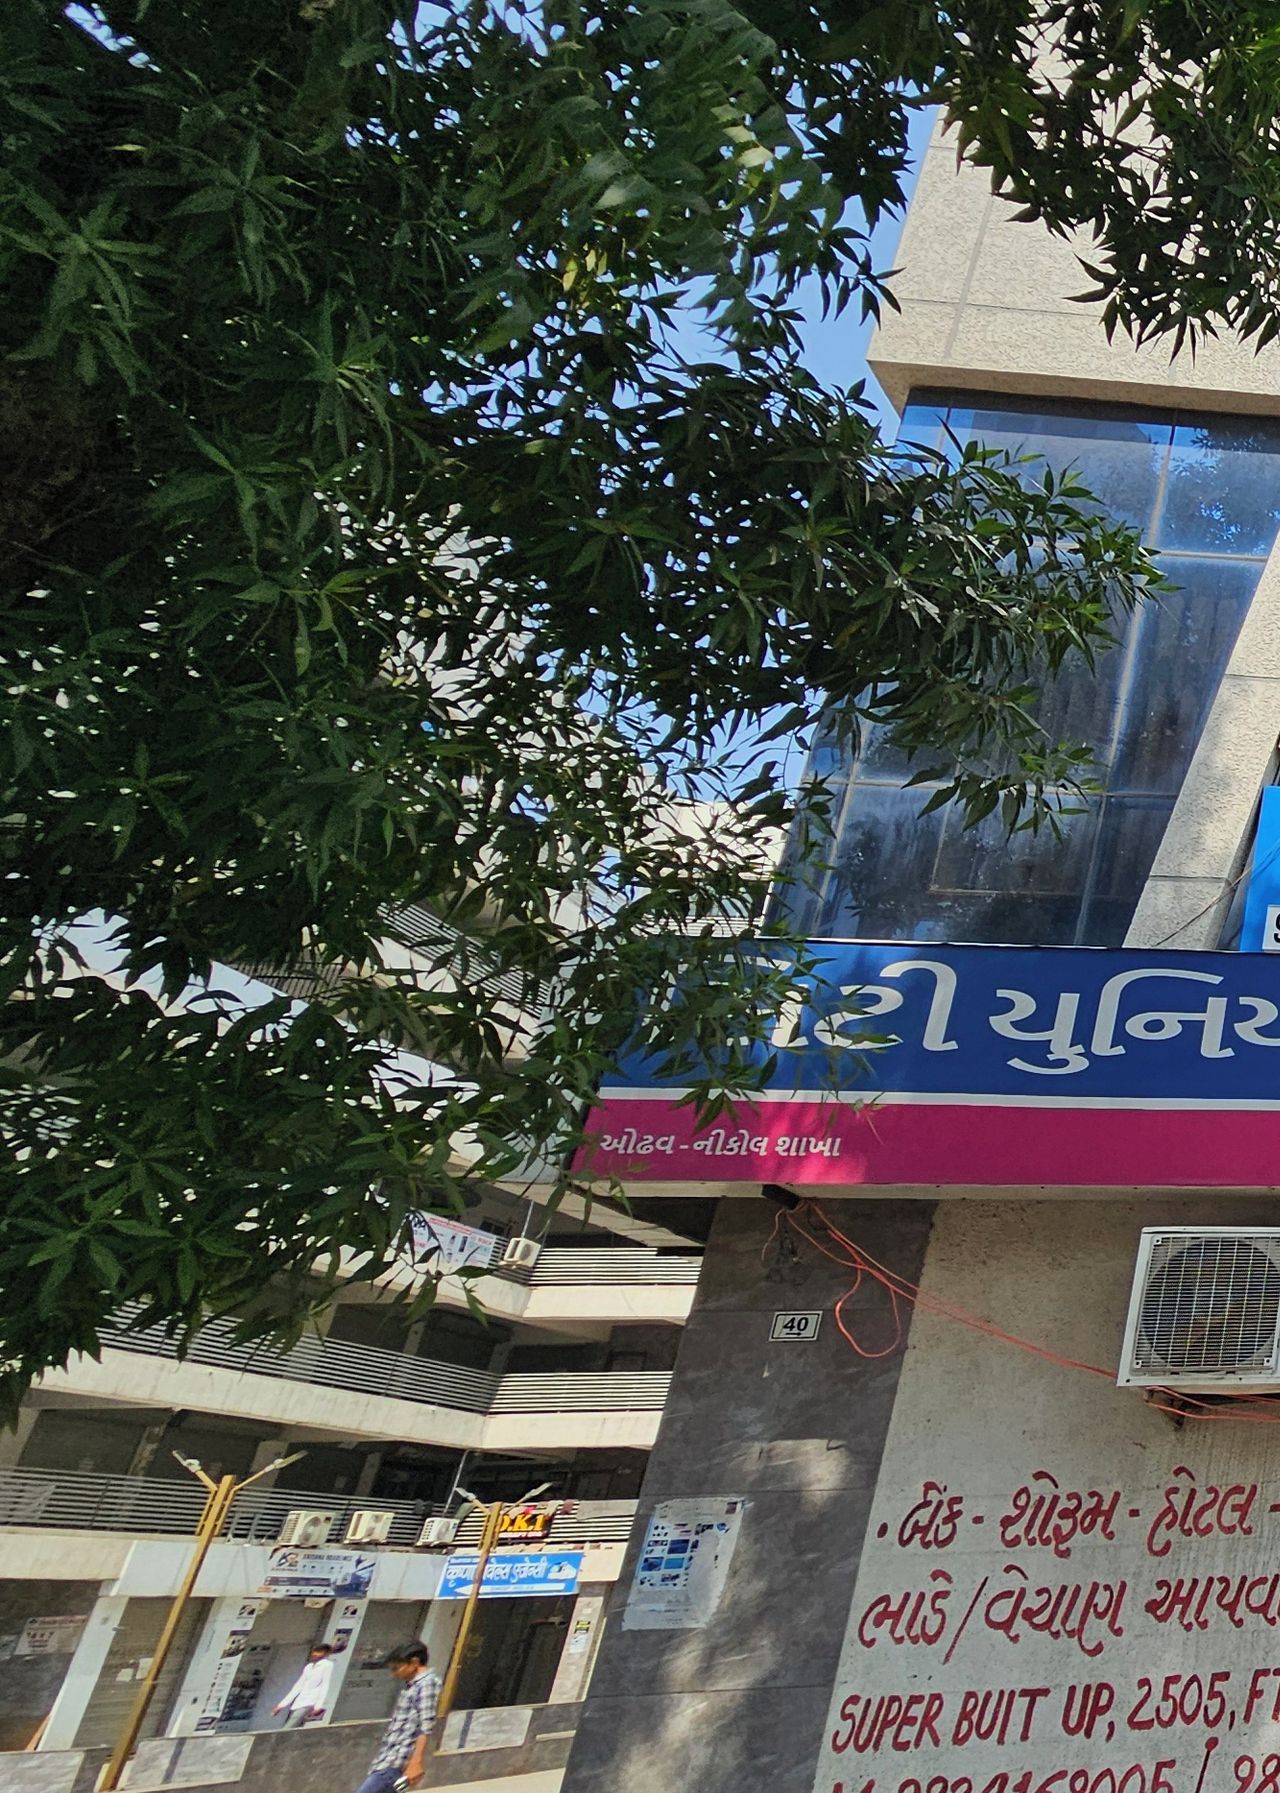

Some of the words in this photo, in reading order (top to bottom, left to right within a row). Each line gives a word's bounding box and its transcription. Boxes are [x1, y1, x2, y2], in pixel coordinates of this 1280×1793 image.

[600, 1128, 675, 1156] ઓઢવ
[774, 1136, 841, 1157] શાખા
[783, 1315, 809, 1333] 40
[1147, 1465, 1258, 1557] હોટલ
[831, 1692, 945, 1754] SUPER
[951, 1687, 1051, 1747] BUIT
